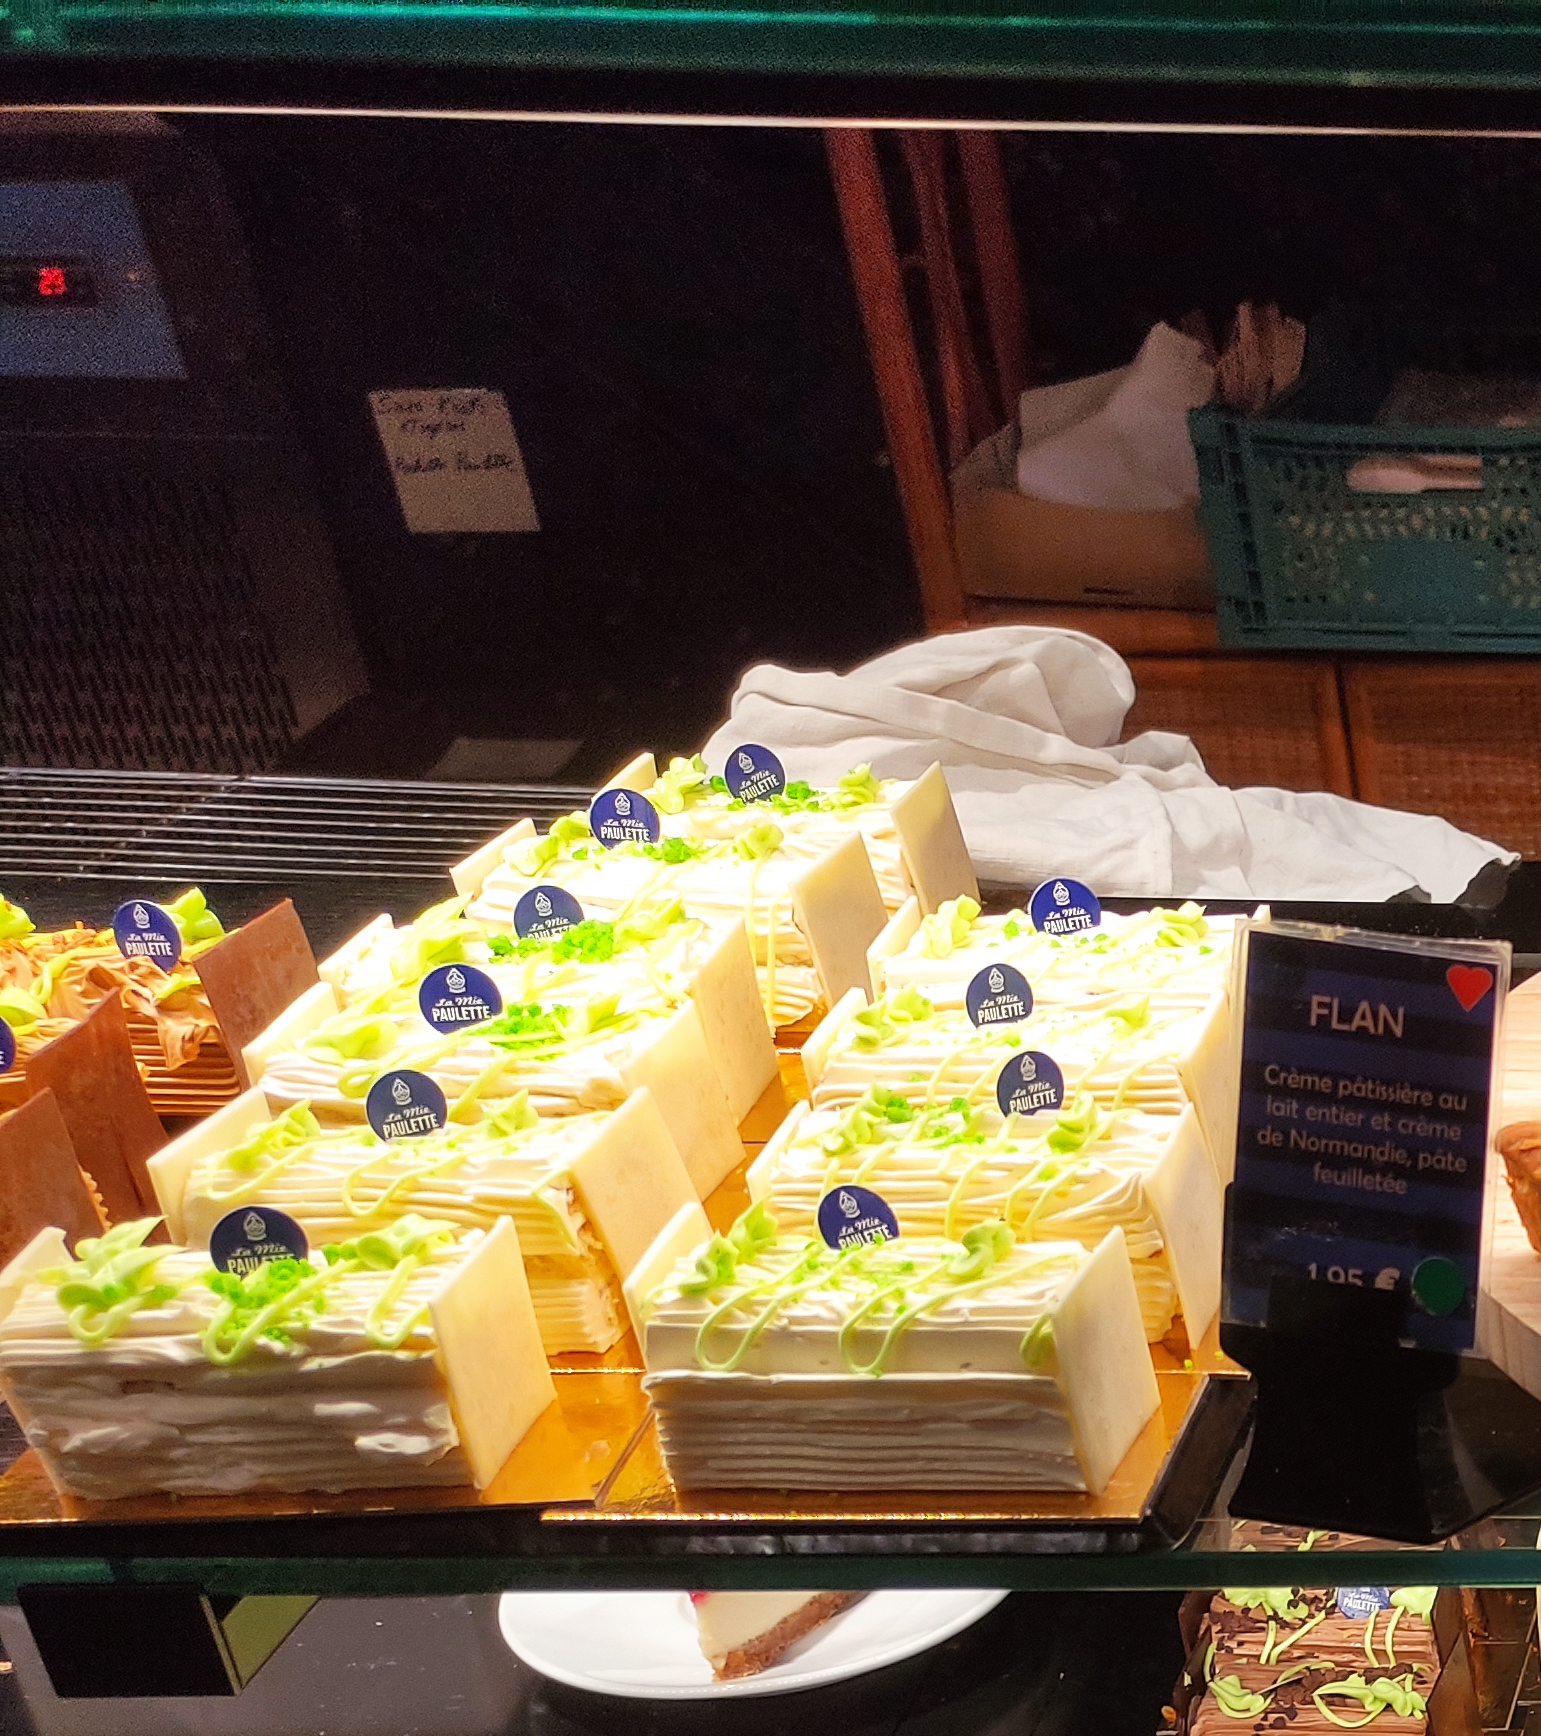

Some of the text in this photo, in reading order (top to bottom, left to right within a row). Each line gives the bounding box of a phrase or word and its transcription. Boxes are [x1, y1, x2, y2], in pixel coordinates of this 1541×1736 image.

[741, 770, 770, 789] La Mie
[740, 774, 780, 803] PAULETTE
[603, 819, 644, 827] La Mie
[600, 827, 650, 841] PAULETTE
[1065, 908, 1085, 917] Mie
[529, 917, 568, 932] La Mie
[1043, 916, 1092, 934] PAULETTE
[127, 932, 164, 941] La Mie
[125, 941, 172, 957] PAULETTE
[436, 995, 483, 1006] La Mie
[980, 995, 1019, 1008] La Mie
[433, 1005, 491, 1022] PAULETTE
[977, 1001, 1027, 1023] PAULETTE
[1309, 994, 1405, 1038] FLAN
[1011, 1082, 1050, 1097] La Mie
[1264, 1063, 1468, 1111] Crème pâtissière au
[1009, 1091, 1057, 1113] PAULETTE
[385, 1109, 429, 1123] La Mie
[1265, 1095, 1462, 1140] lait entier et crème
[382, 1115, 439, 1138] PAULETTE
[1256, 1125, 1284, 1147] de
[1288, 1129, 1412, 1168] Normandie,
[1312, 1161, 1408, 1194] feuilletée
[840, 1218, 879, 1235] La Mie
[231, 1246, 277, 1257] La Mie
[1306, 1262, 1364, 1287] 195
